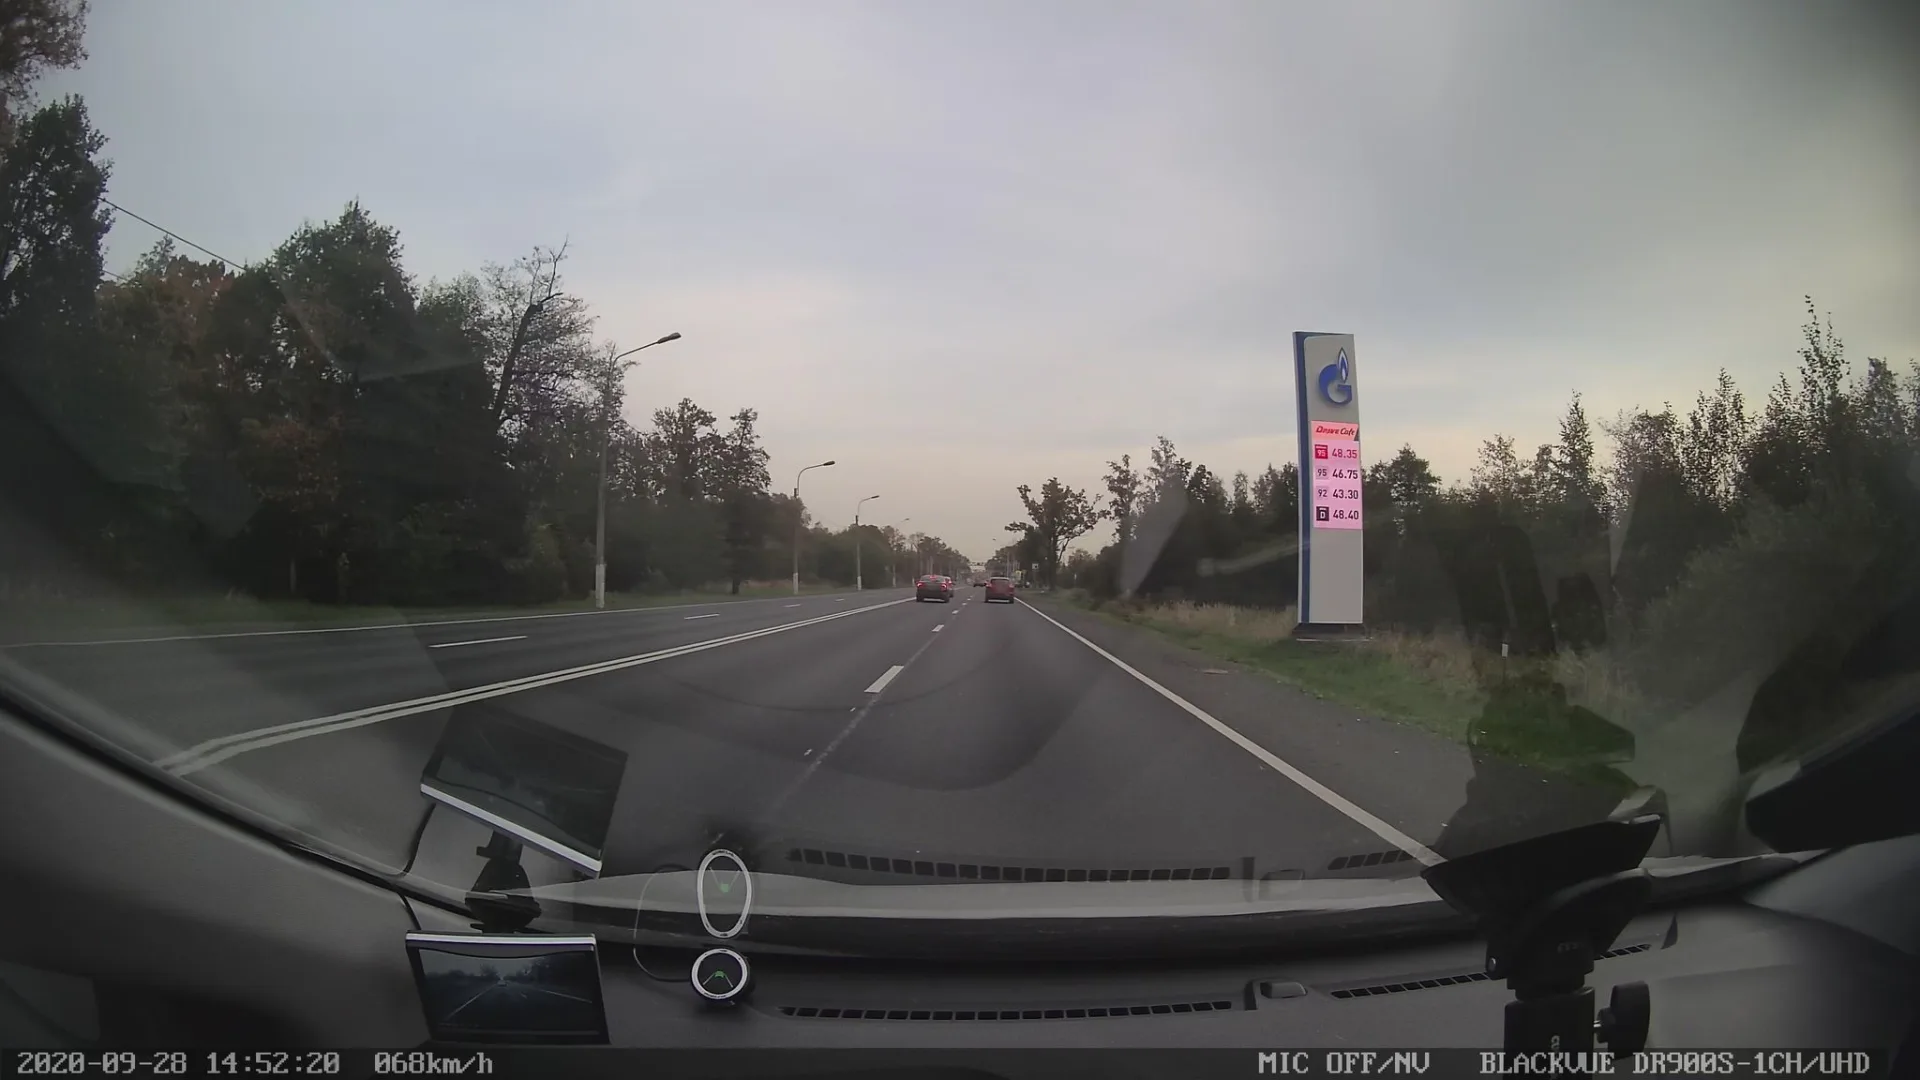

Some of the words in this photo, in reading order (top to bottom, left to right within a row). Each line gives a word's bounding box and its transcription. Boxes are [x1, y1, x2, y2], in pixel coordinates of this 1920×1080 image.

[1331, 448, 1358, 459] 48.35
[1317, 468, 1328, 477] 95
[1332, 468, 1359, 480] 46.75
[1317, 488, 1328, 498] 92
[1332, 488, 1359, 500] 43.30
[1332, 509, 1359, 520] 48.40
